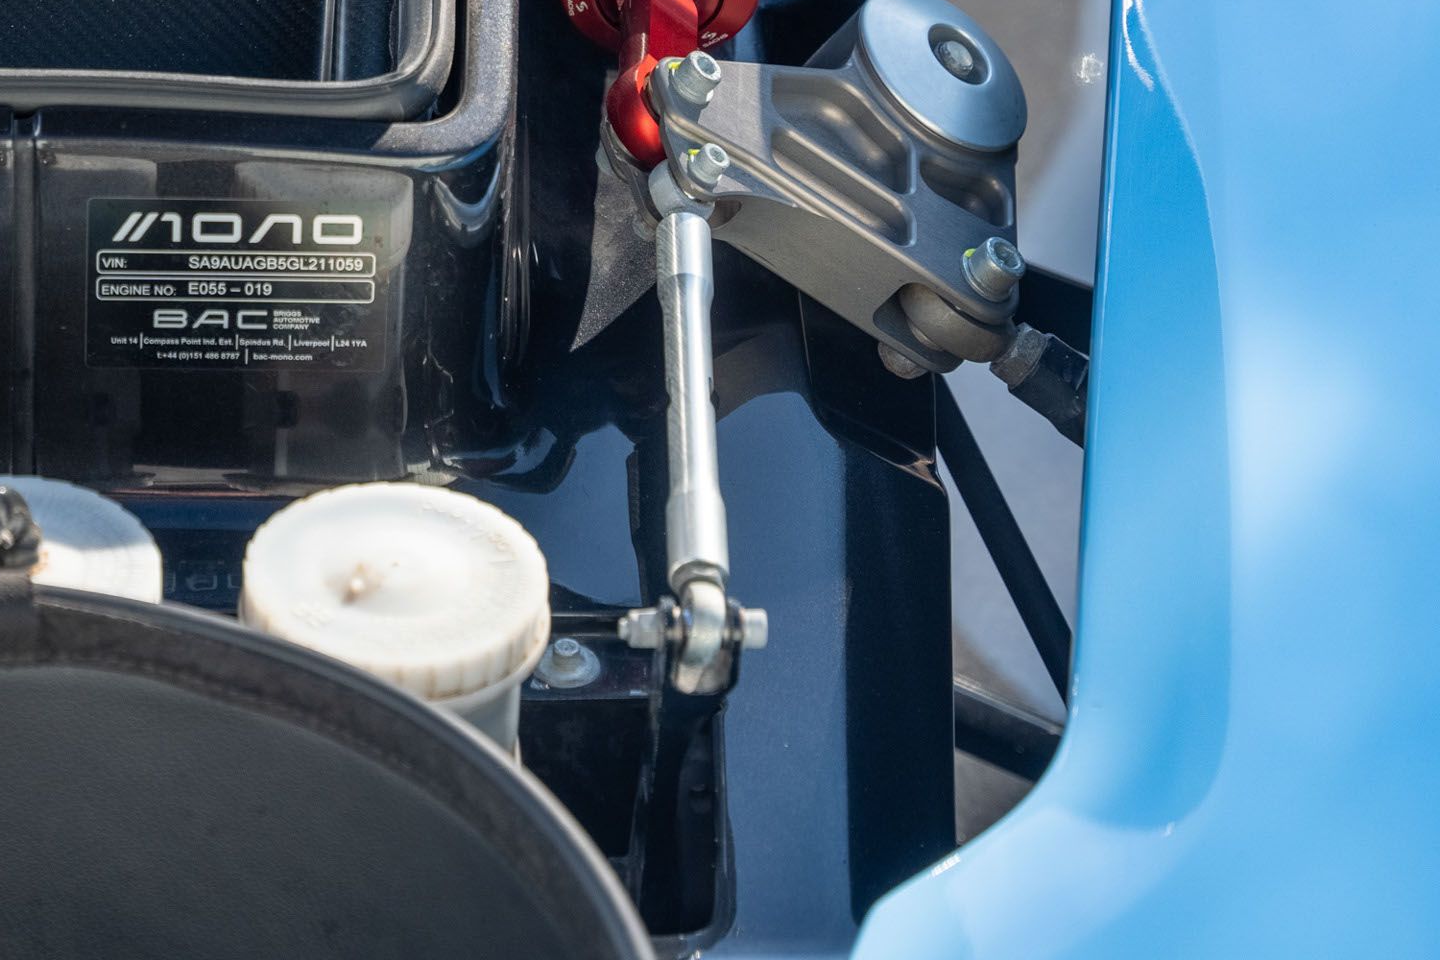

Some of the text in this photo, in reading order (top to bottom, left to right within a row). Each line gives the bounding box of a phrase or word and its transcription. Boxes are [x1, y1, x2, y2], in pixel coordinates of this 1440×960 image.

[101, 256, 364, 271] VIN: SA9AUAGB5GL211059
[101, 284, 151, 296] ENGINE
[153, 284, 177, 297] NO:
[188, 282, 226, 295] E055
[244, 282, 273, 296] 019
[153, 308, 268, 329] BAC
[110, 337, 127, 345] Unit
[128, 337, 139, 345] 14
[143, 338, 180, 347] Compass
[180, 338, 201, 346] Point
[293, 339, 330, 349] Liverpool
[335, 340, 350, 348] L24
[252, 353, 314, 361] bac-mono.com
